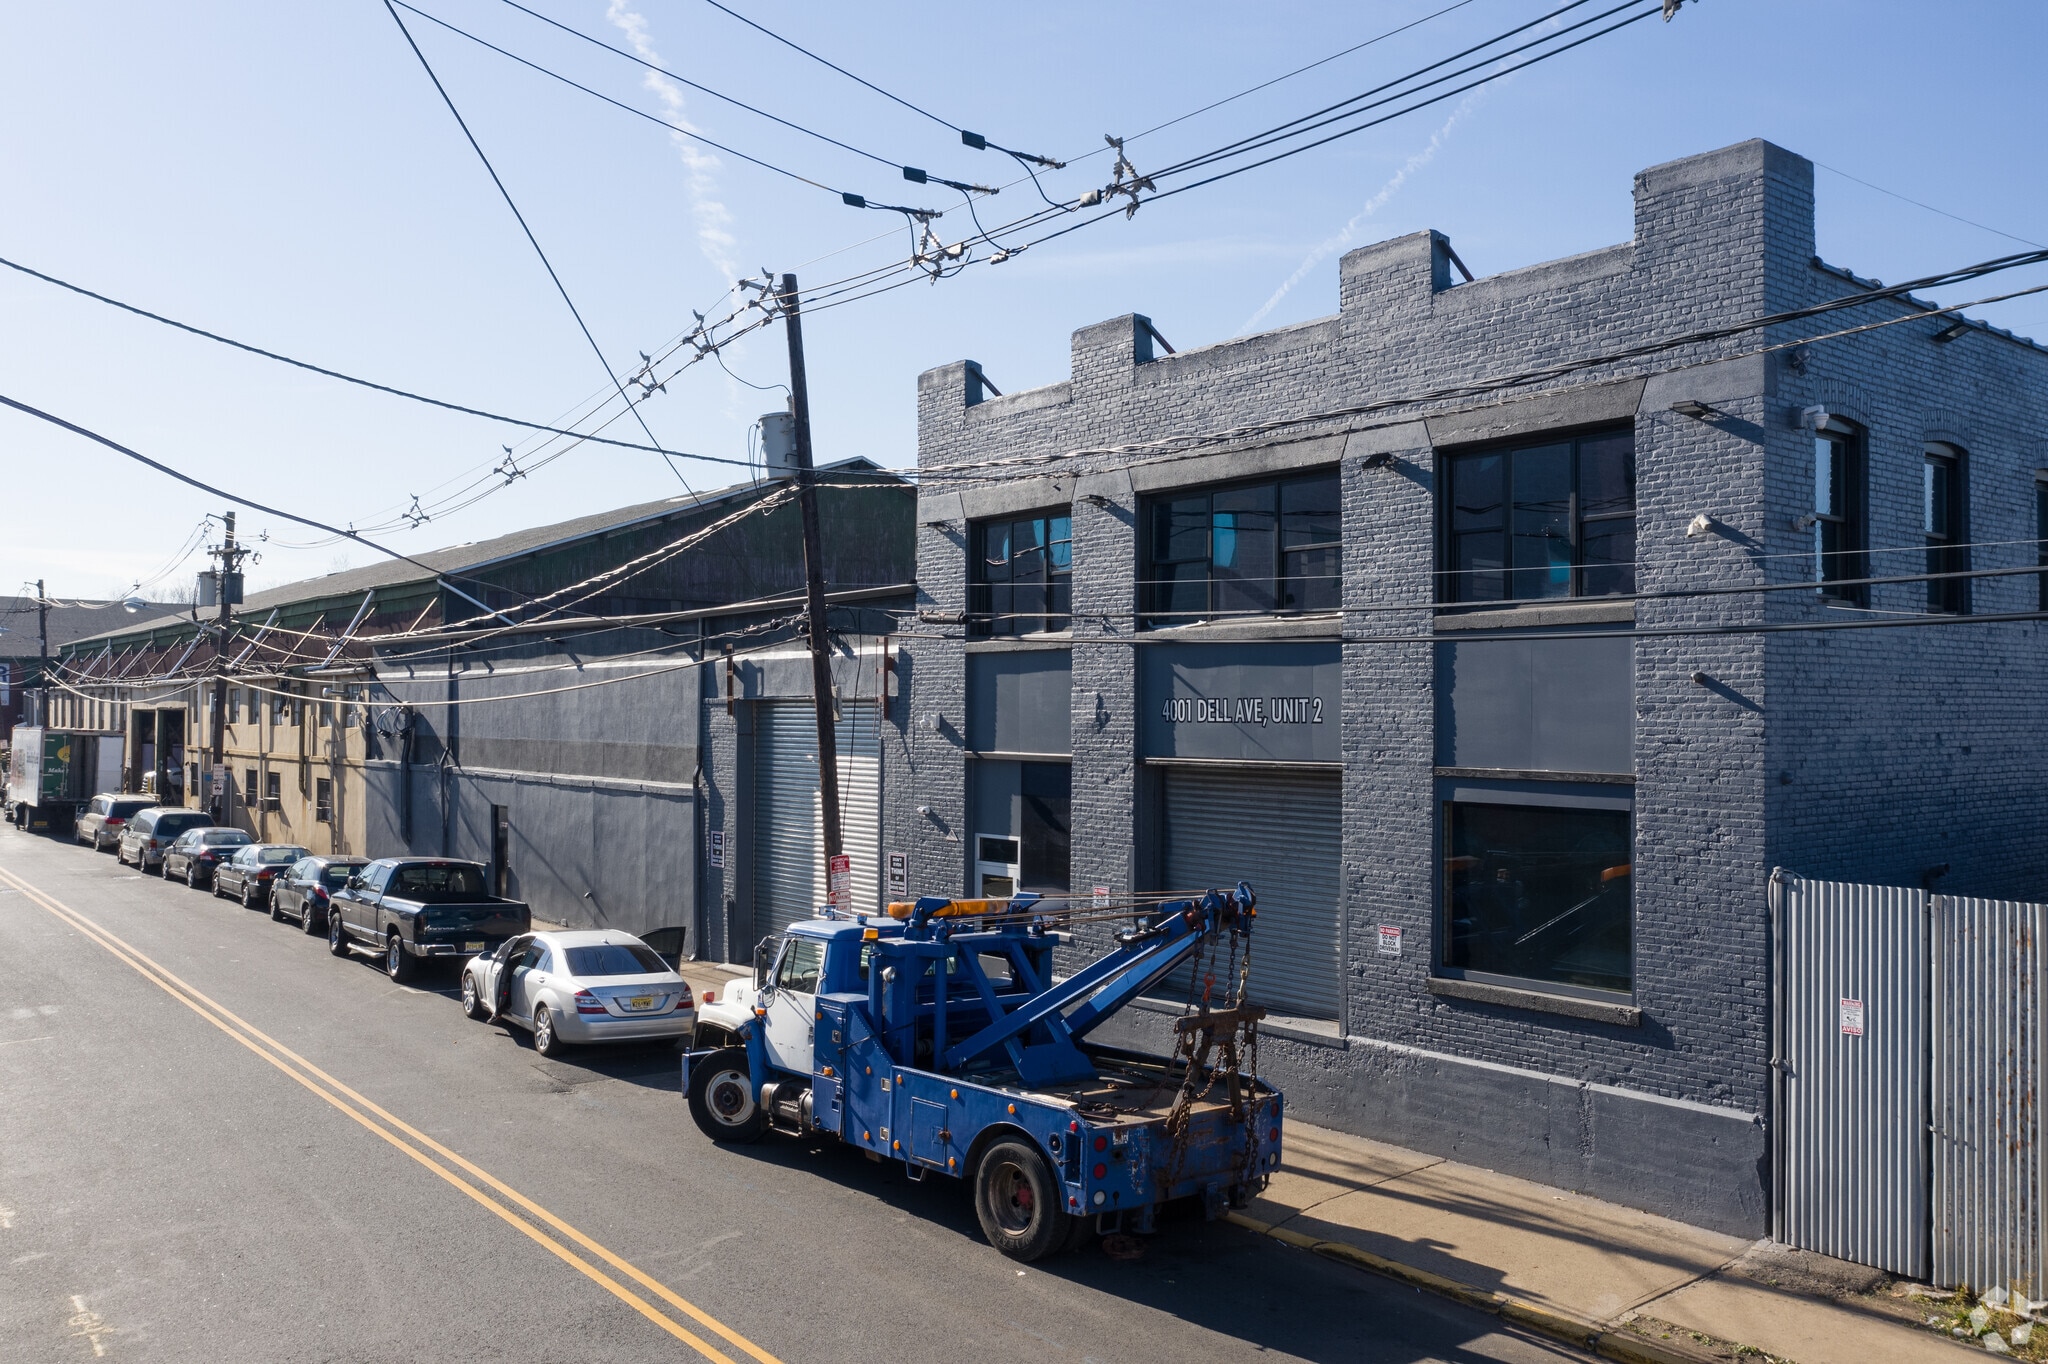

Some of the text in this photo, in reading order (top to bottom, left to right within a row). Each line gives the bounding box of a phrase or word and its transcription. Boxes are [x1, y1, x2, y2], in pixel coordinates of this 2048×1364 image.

[1162, 697, 1323, 728] 4001 DELL AVE, UNIT 2
[1842, 1026, 1862, 1034] AVISO
